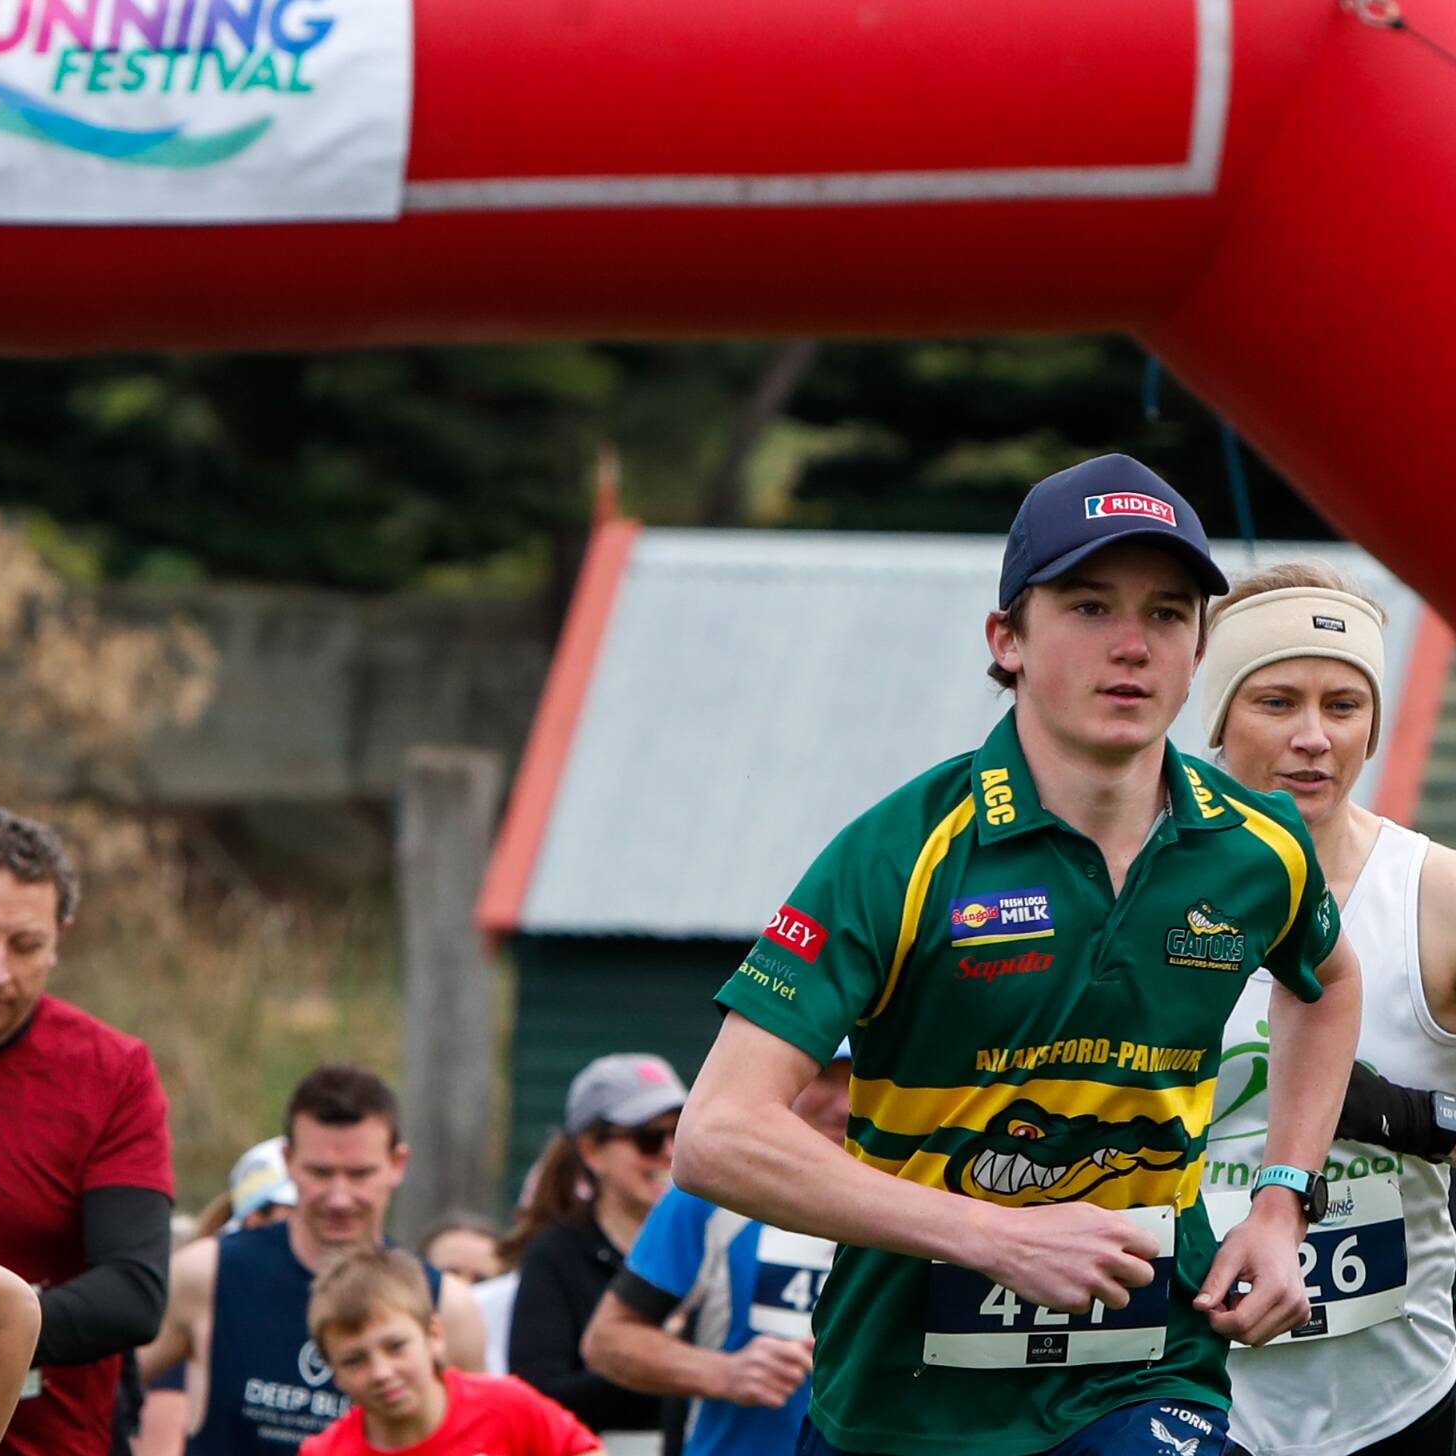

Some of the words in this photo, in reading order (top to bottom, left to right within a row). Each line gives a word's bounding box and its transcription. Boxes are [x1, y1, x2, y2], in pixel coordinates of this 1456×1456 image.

[52, 48, 314, 94] FESTIVAL
[1112, 498, 1169, 517] RIDLEY
[980, 768, 1016, 826] ACC
[952, 906, 999, 925] Sungold
[999, 898, 1023, 909] FRESH
[1025, 896, 1048, 906] LOCAL
[1001, 905, 1050, 924] MILK
[1167, 929, 1244, 961] GATORS
[955, 950, 1056, 984] Saputo
[772, 977, 797, 1000] Vet
[1298, 1234, 1367, 1298] 26
[245, 1378, 311, 1410] DEEP
